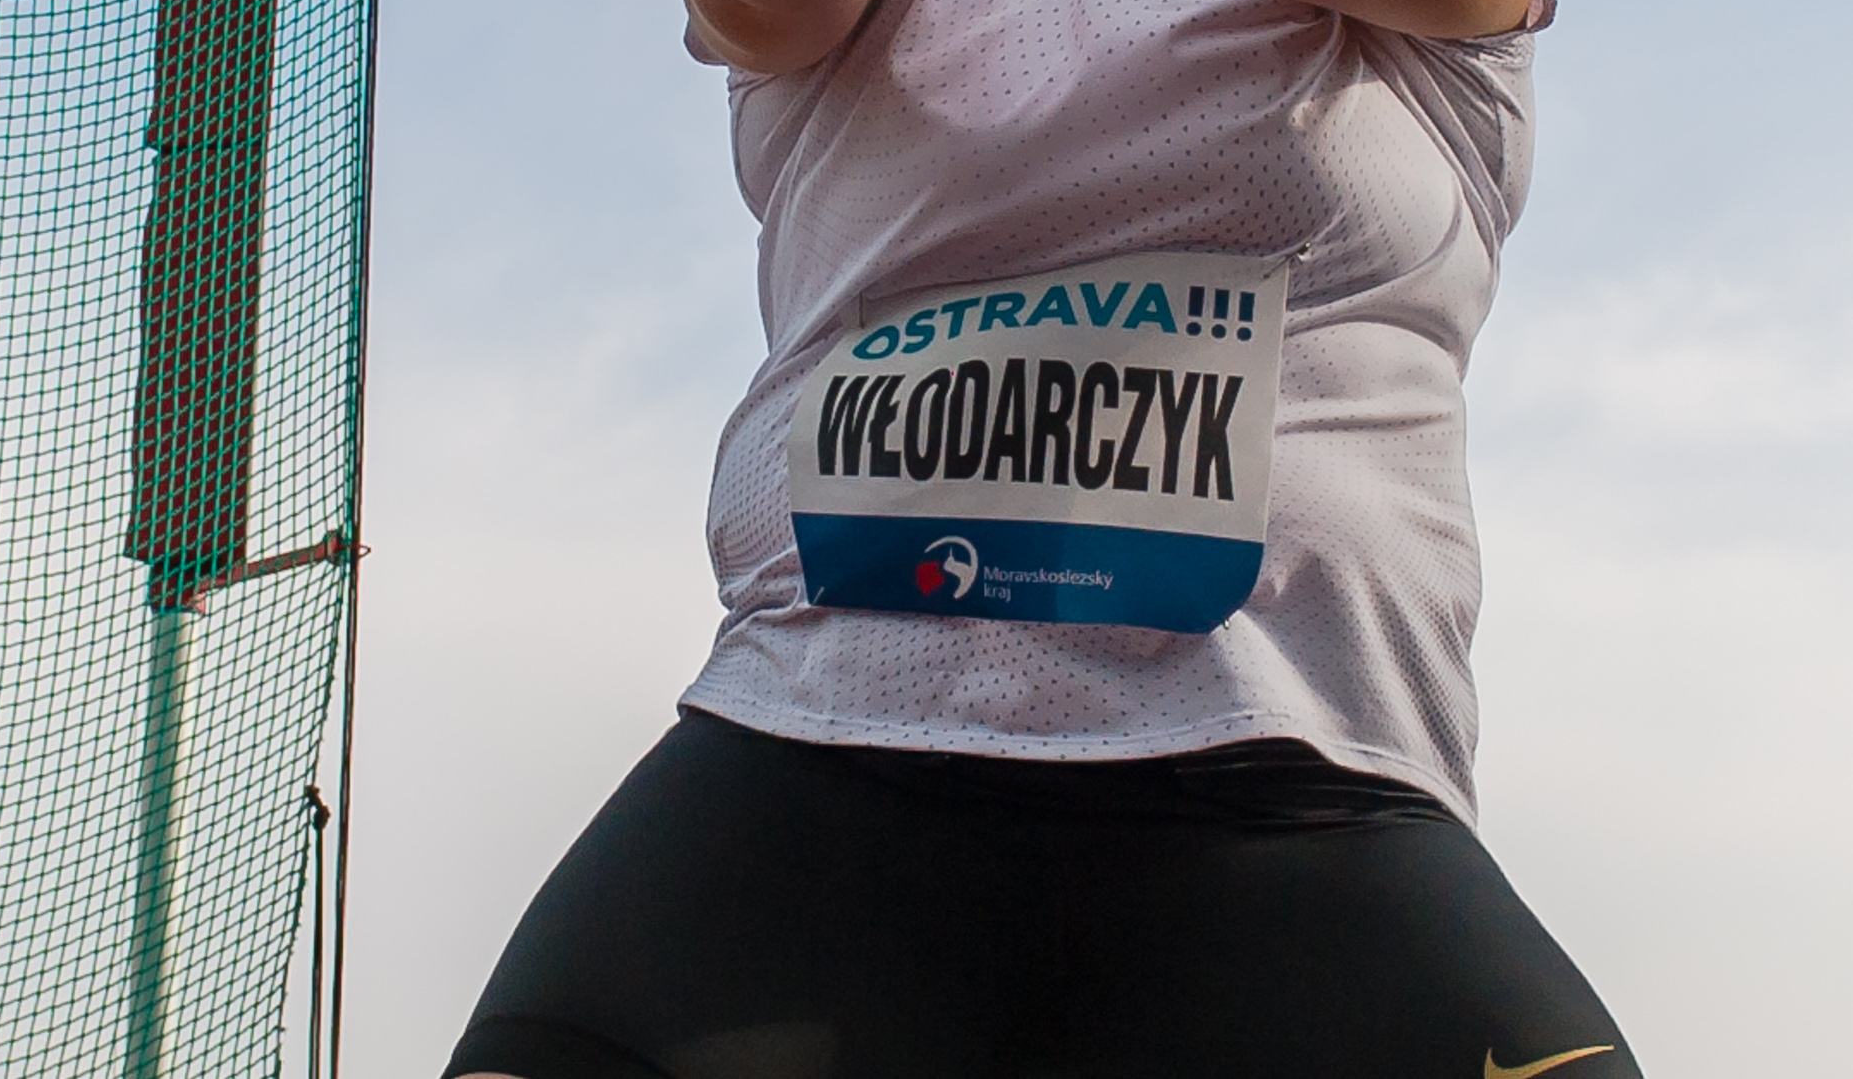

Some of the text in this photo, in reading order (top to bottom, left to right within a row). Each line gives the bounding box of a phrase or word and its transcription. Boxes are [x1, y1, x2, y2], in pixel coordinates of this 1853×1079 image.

[852, 282, 1255, 360] OSTRAVA!!!
[817, 358, 1243, 501] WŁODARCZYK
[983, 566, 1114, 590] Moravskoslezský
[983, 583, 1011, 602] kraj
